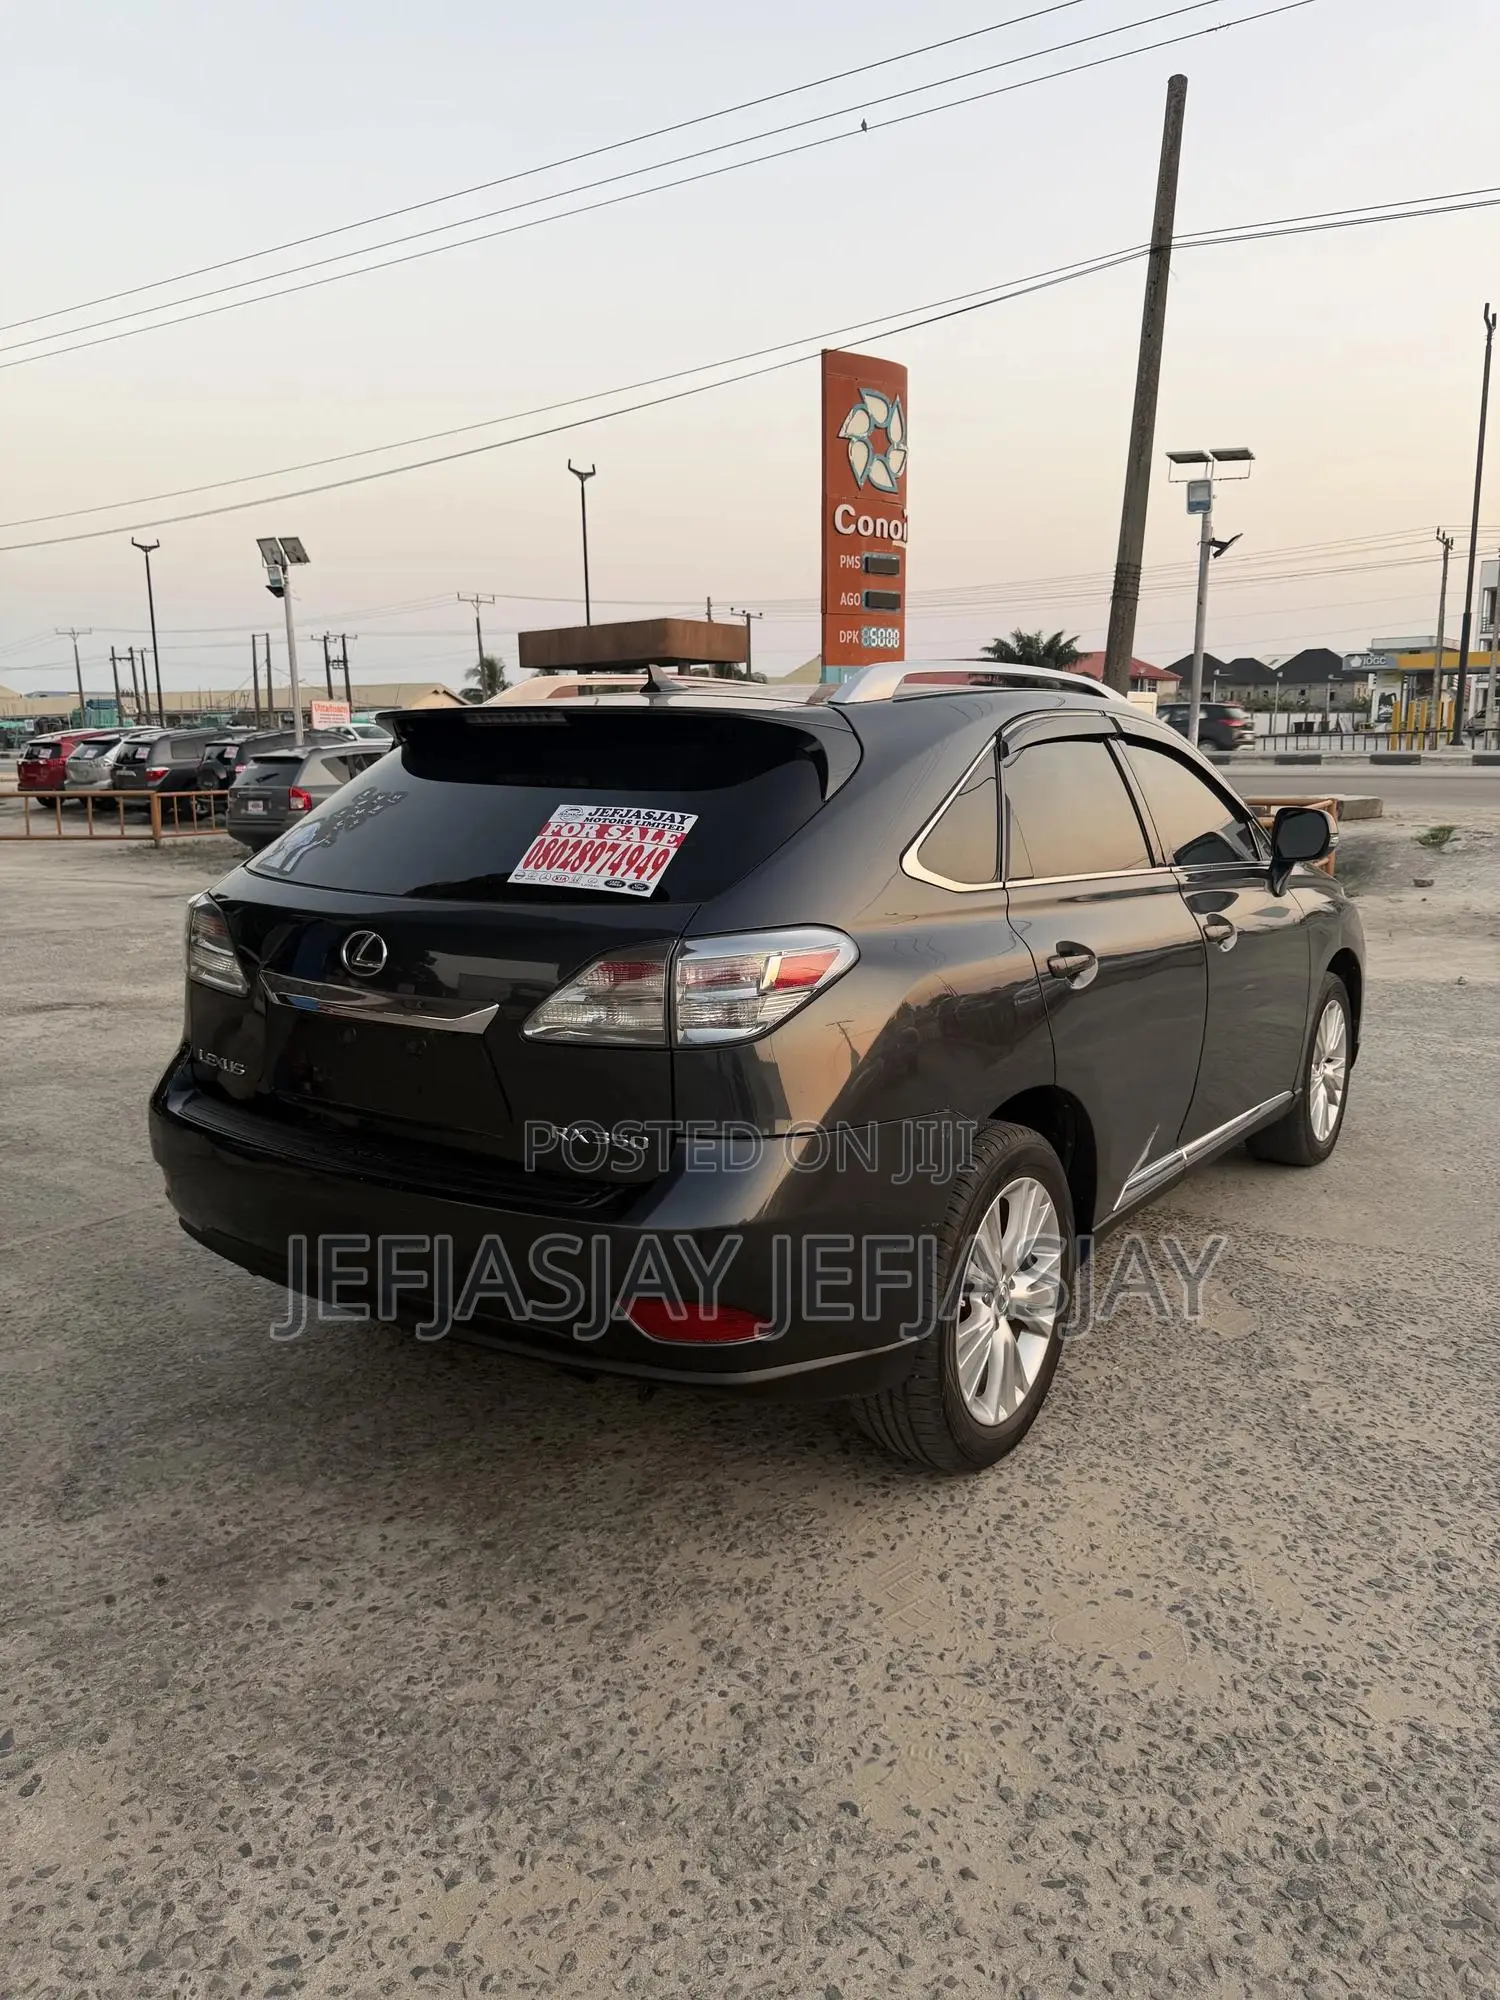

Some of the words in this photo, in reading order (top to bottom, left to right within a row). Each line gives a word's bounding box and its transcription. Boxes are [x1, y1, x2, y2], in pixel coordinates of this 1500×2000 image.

[840, 555, 861, 569] PMS
[840, 592, 861, 606] AGO
[839, 630, 859, 644] DPK
[583, 816, 633, 826] MOTORS
[634, 819, 685, 832] LIMITED
[588, 807, 692, 825] JEFJASJAY
[542, 822, 601, 839] FOR
[604, 825, 683, 848] SALE
[522, 837, 671, 882] 08028974949
